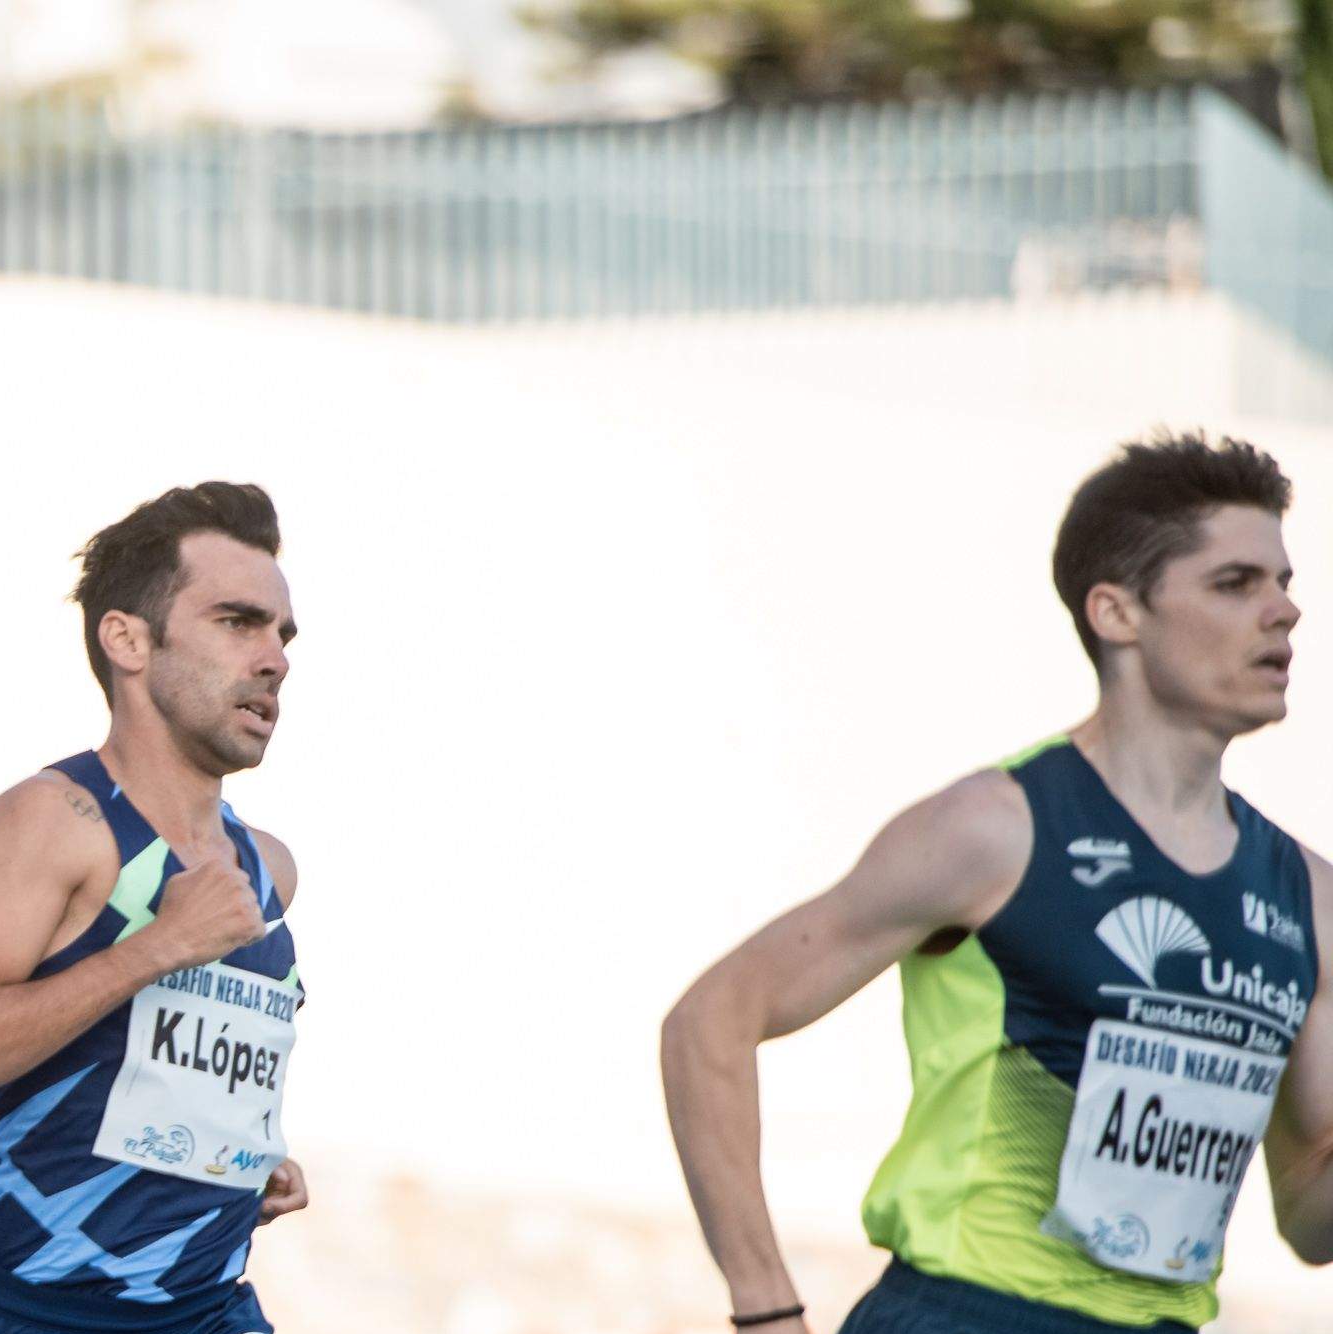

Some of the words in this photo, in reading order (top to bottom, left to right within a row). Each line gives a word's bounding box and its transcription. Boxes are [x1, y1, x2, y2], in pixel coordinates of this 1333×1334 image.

[215, 974, 262, 1010] NERJA
[264, 989, 297, 1023] 2020
[1127, 997, 1243, 1041] Fundación
[151, 1006, 280, 1094] K.López
[1096, 1032, 1178, 1075] DESAFÍO
[1184, 1047, 1240, 1089] NERJA
[262, 1108, 271, 1140] 1
